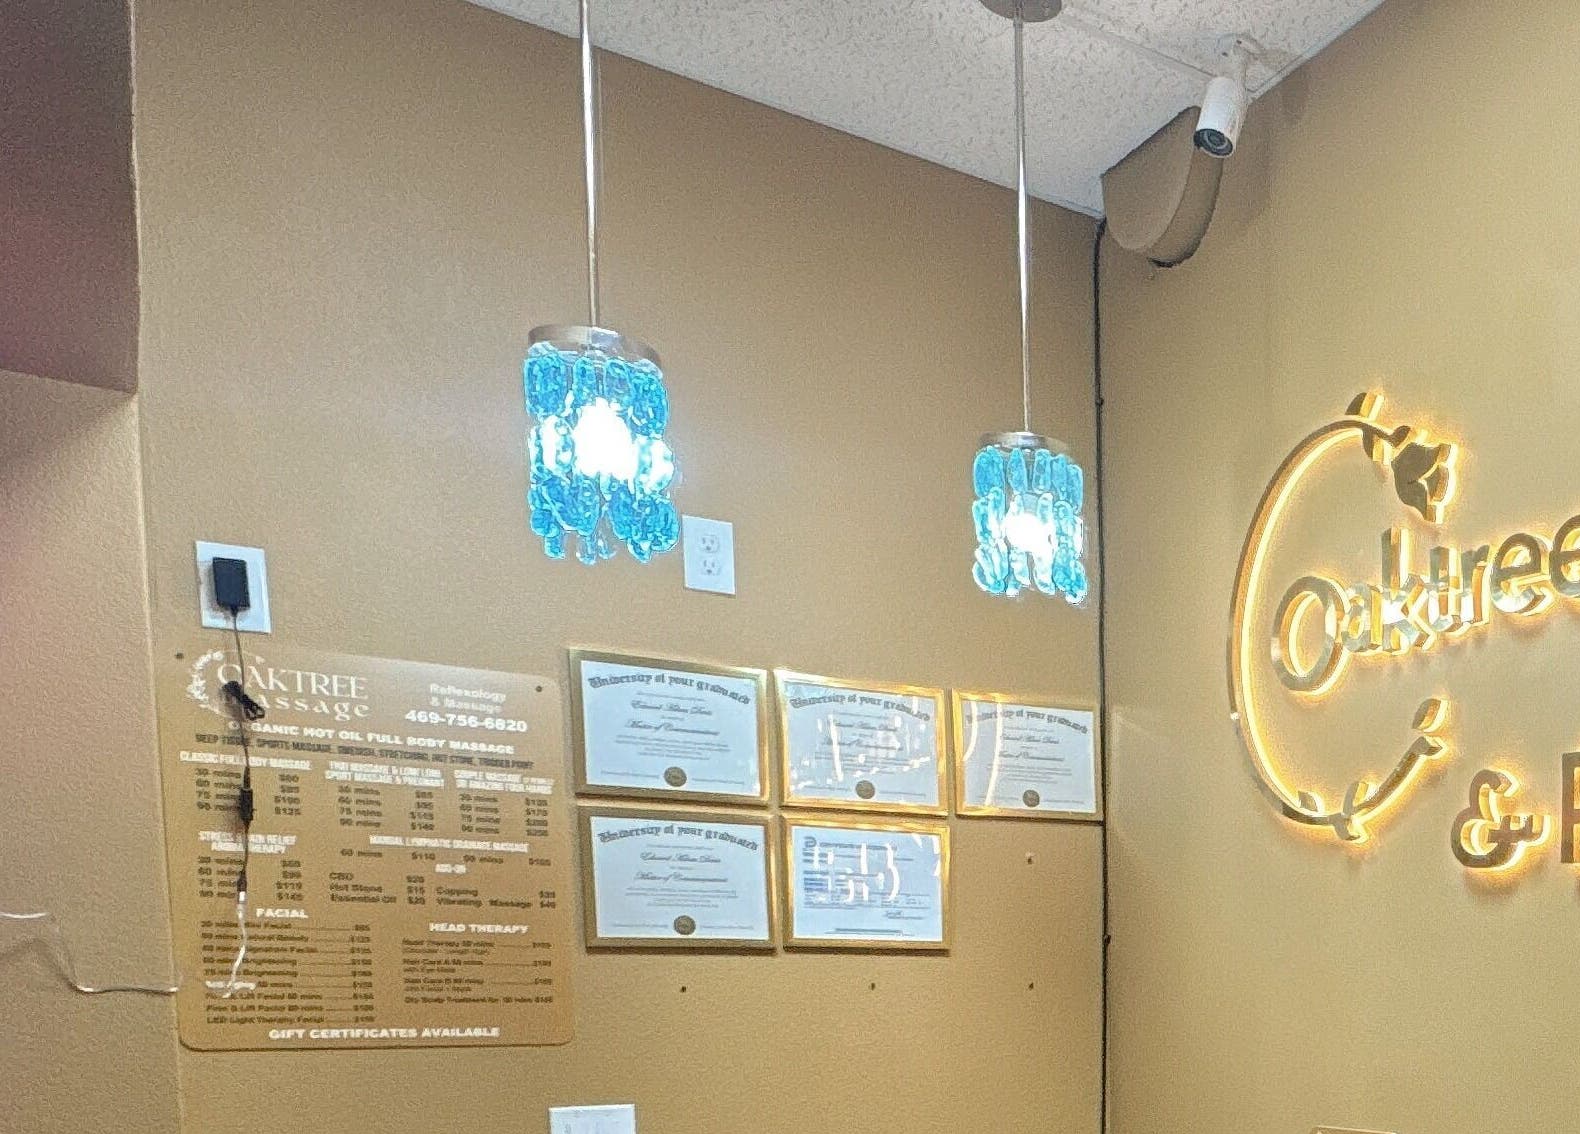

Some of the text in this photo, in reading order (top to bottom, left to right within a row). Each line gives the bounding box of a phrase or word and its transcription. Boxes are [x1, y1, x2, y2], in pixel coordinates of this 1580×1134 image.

[217, 664, 368, 699] OAKTREE
[588, 674, 652, 688] University
[669, 676, 694, 686] your
[240, 694, 369, 721] assage
[405, 709, 528, 732] 469-756-6820
[229, 721, 514, 755] OGANIC HOT OIL FULL BODY MASSAGE
[1450, 769, 1551, 868] &
[678, 826, 703, 836] your
[256, 908, 308, 918] FACIAL
[429, 923, 528, 933] HEAD THERAPY
[269, 1027, 500, 1039] GIFT CERTIFICATES AVAILABLE
